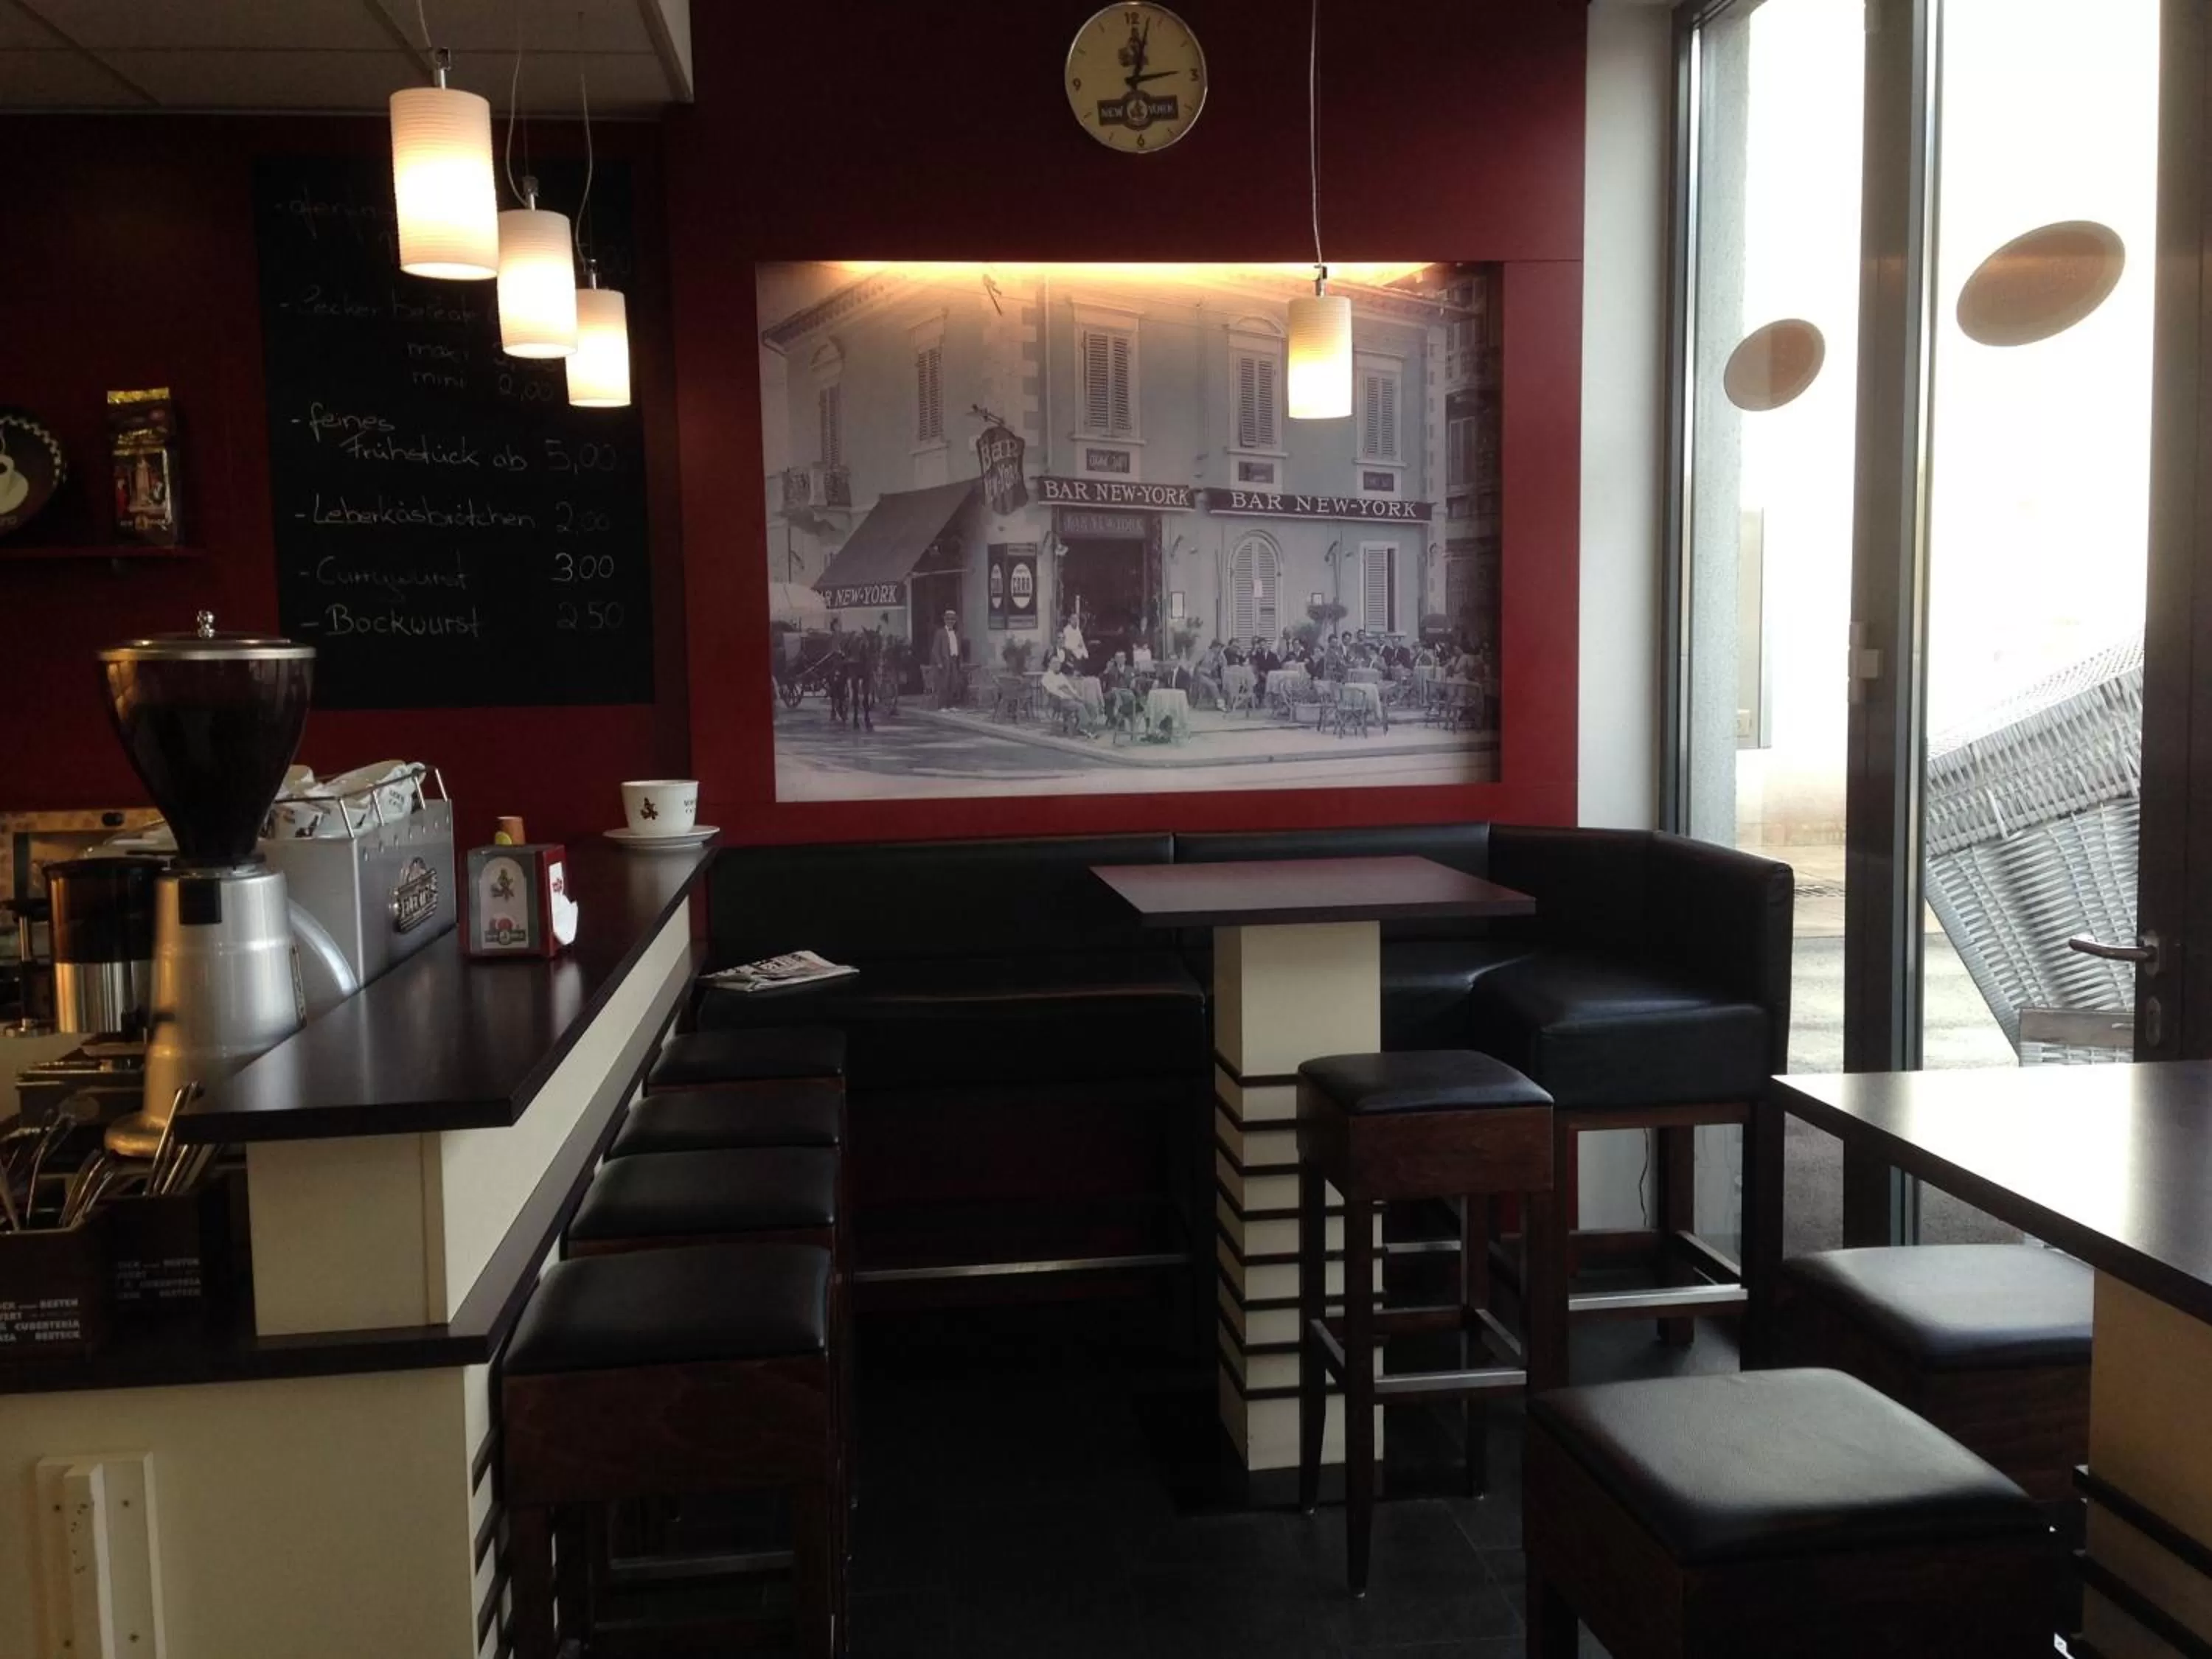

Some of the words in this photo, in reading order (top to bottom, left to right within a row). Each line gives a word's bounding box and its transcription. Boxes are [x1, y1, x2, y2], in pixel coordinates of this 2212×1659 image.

[1124, 12, 1140, 24] 12
[1073, 78, 1082, 91] 9
[1191, 69, 1199, 81] 3
[1101, 105, 1124, 118] NEW
[1137, 134, 1145, 147] 6
[309, 402, 396, 442] feines
[493, 444, 528, 470] ab
[1044, 480, 1089, 500] BAR
[1095, 483, 1190, 505] NEW-YORK
[1231, 492, 1283, 510] BAR
[1294, 495, 1416, 518] NEW-YORK
[324, 602, 481, 637] Bockwurst
